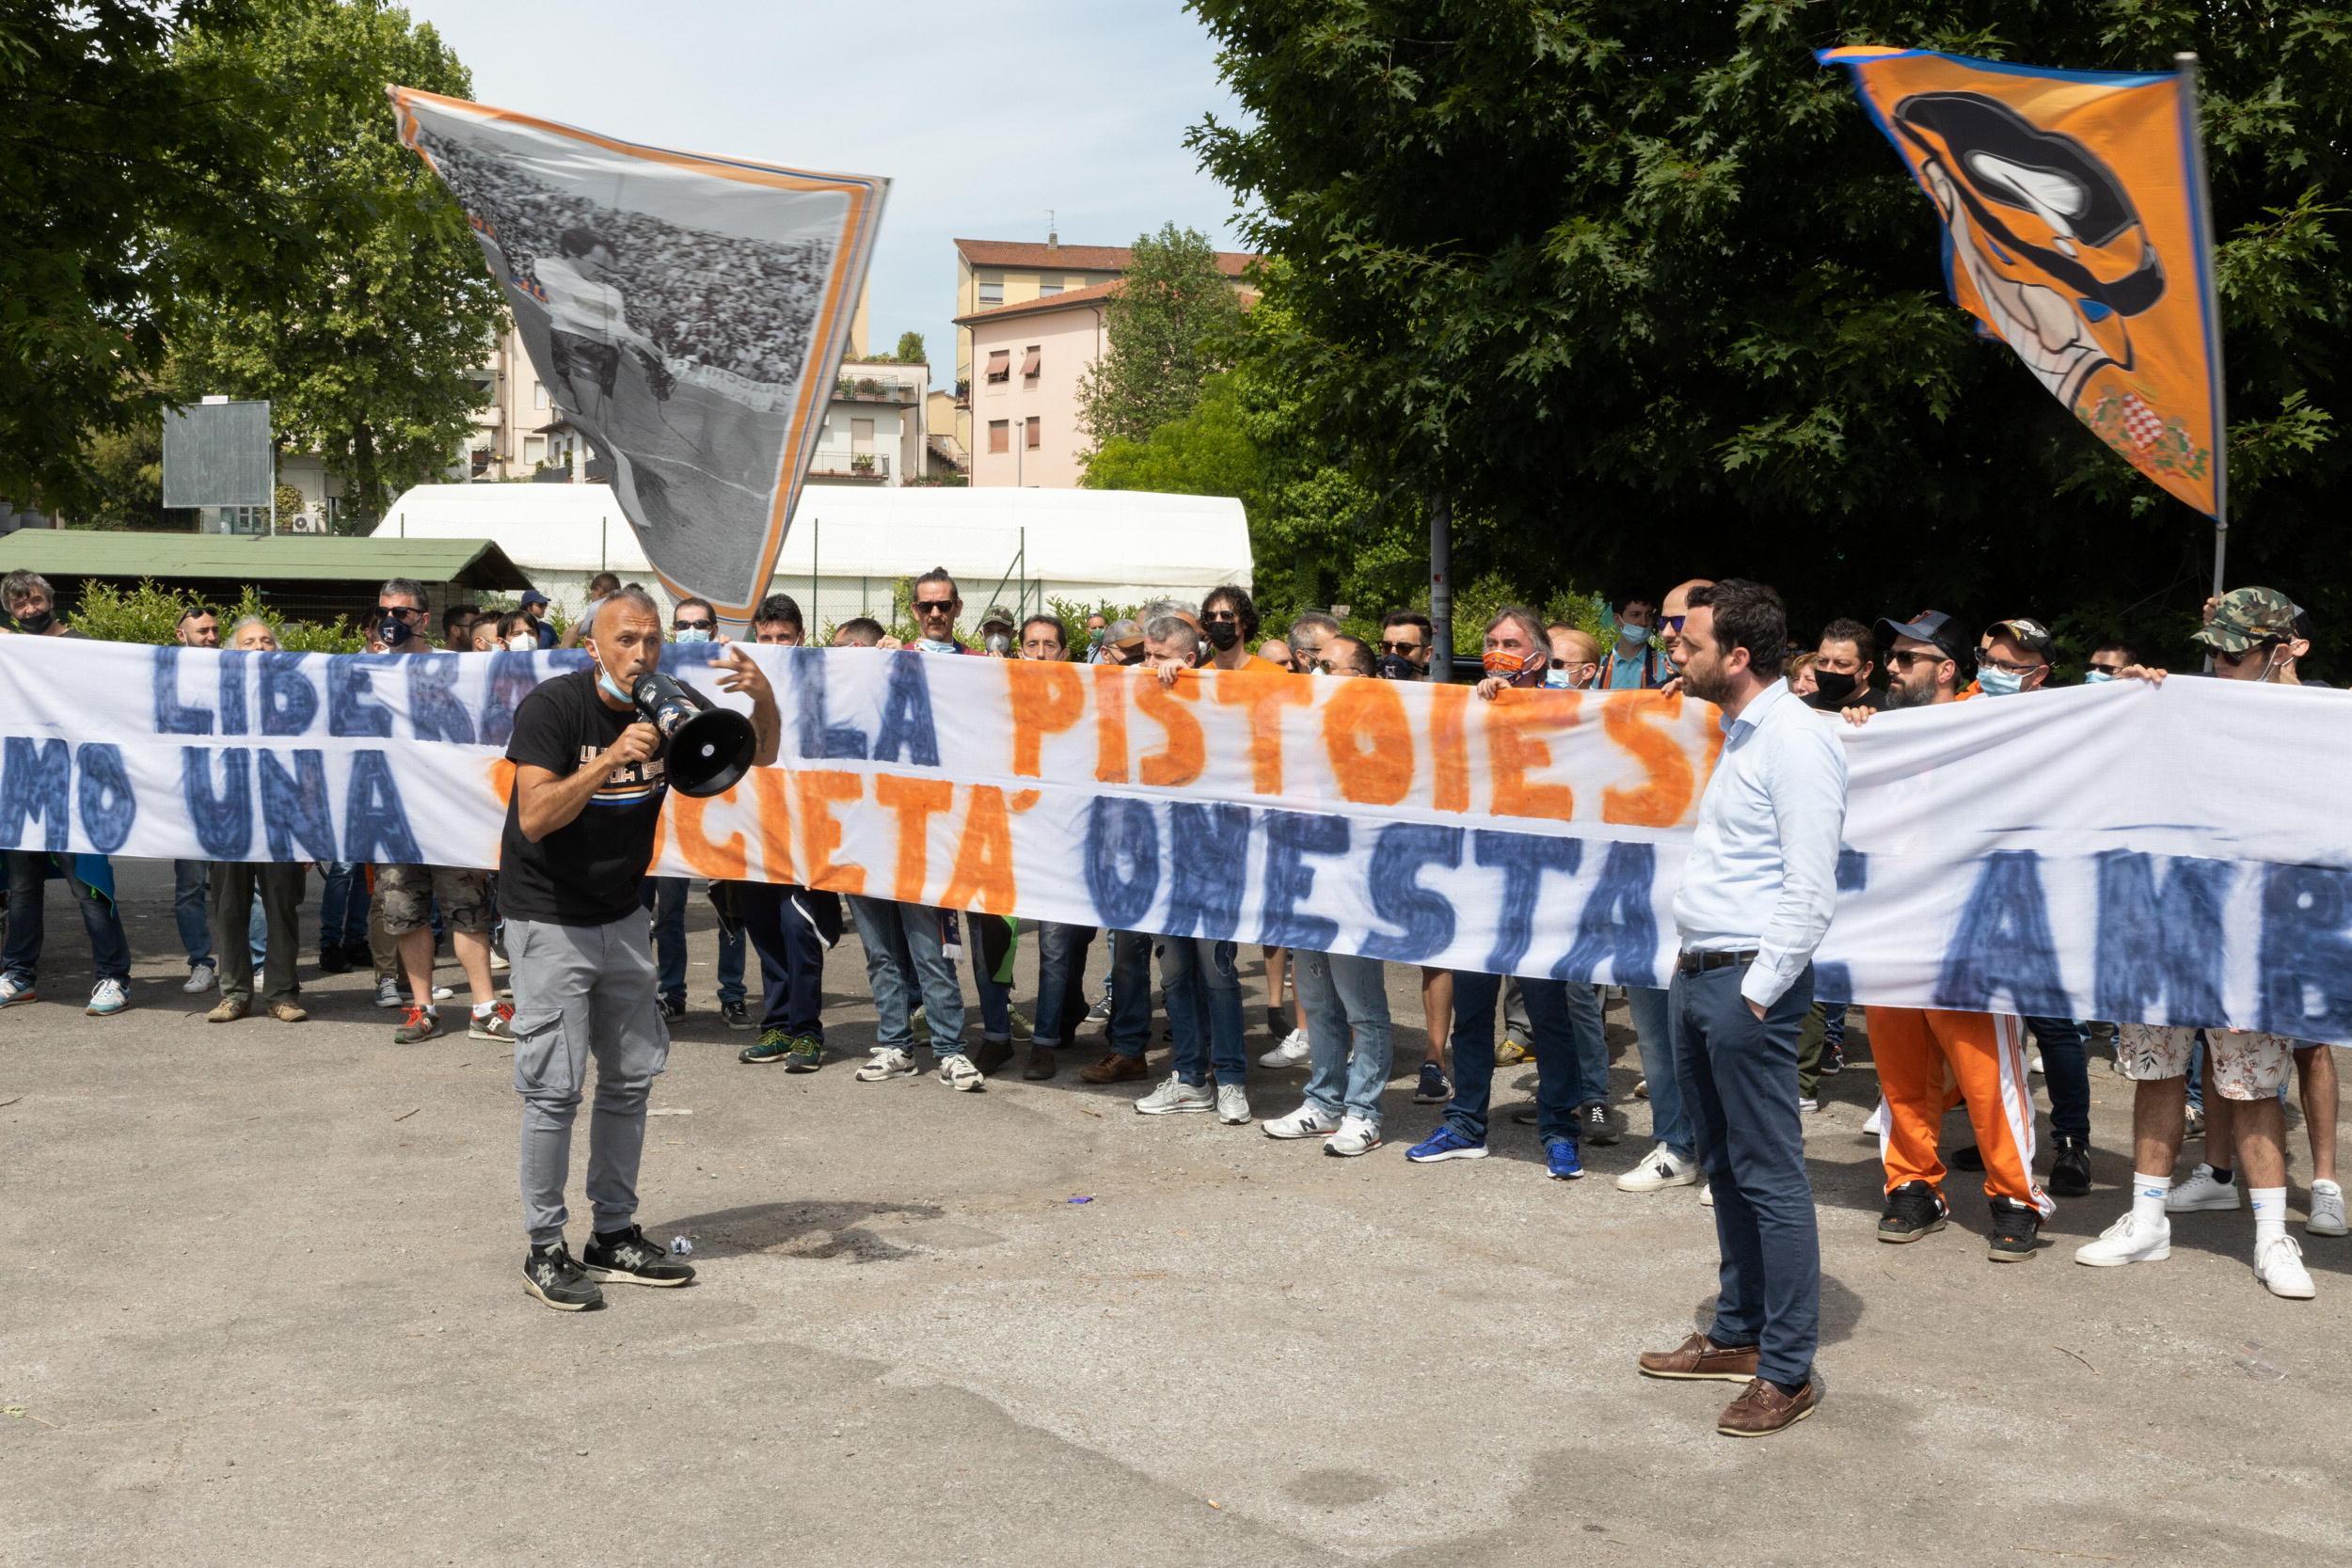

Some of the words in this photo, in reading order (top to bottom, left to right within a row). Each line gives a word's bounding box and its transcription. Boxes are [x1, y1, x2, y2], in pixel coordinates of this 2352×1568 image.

[791, 646, 940, 767] LA
[1008, 659, 1726, 828] PISTOIES
[0, 736, 137, 853] MO
[183, 744, 422, 863] UNA
[1084, 794, 1660, 990] ONESTA
